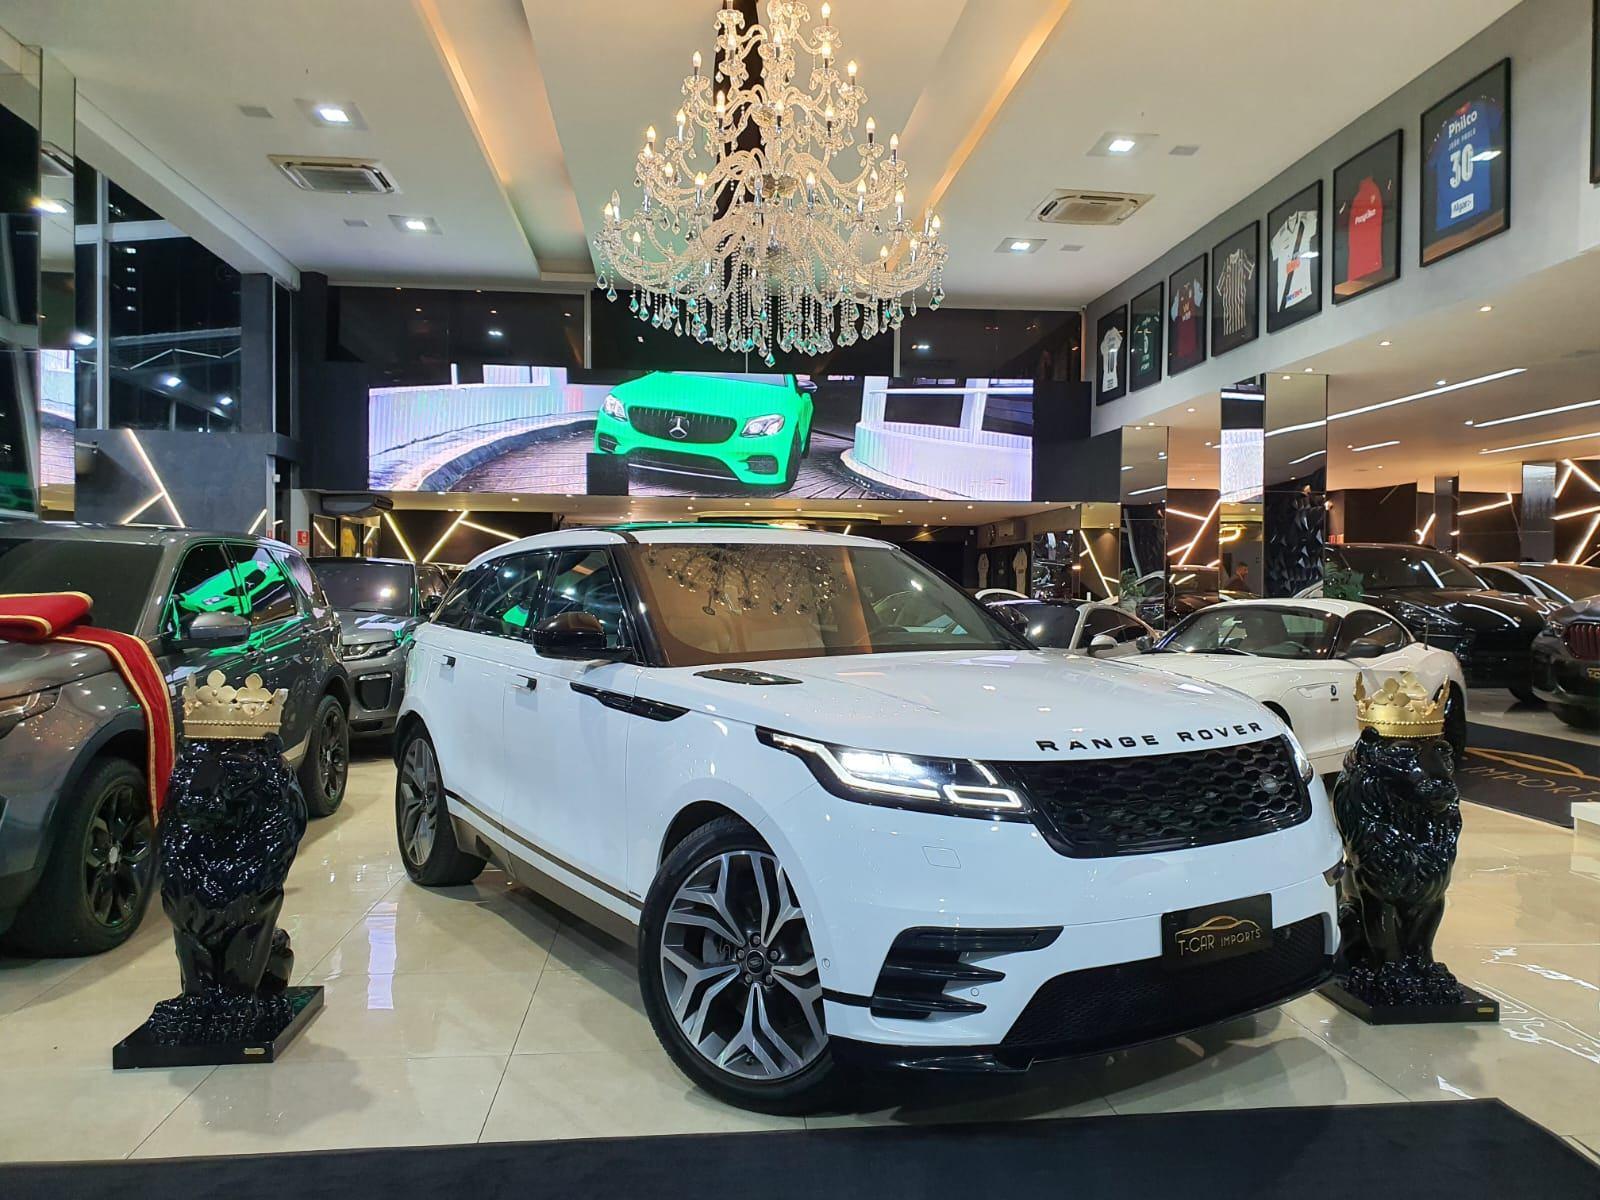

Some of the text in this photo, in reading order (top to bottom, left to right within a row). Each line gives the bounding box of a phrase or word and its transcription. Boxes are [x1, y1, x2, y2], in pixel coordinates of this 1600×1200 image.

[1448, 110, 1478, 138] Philco
[1449, 143, 1474, 189] 30
[1036, 722, 1263, 751] RANGE ROVER
[1460, 765, 1600, 801] IMPORT
[1178, 928, 1262, 956] T-CAR IMPORTS
